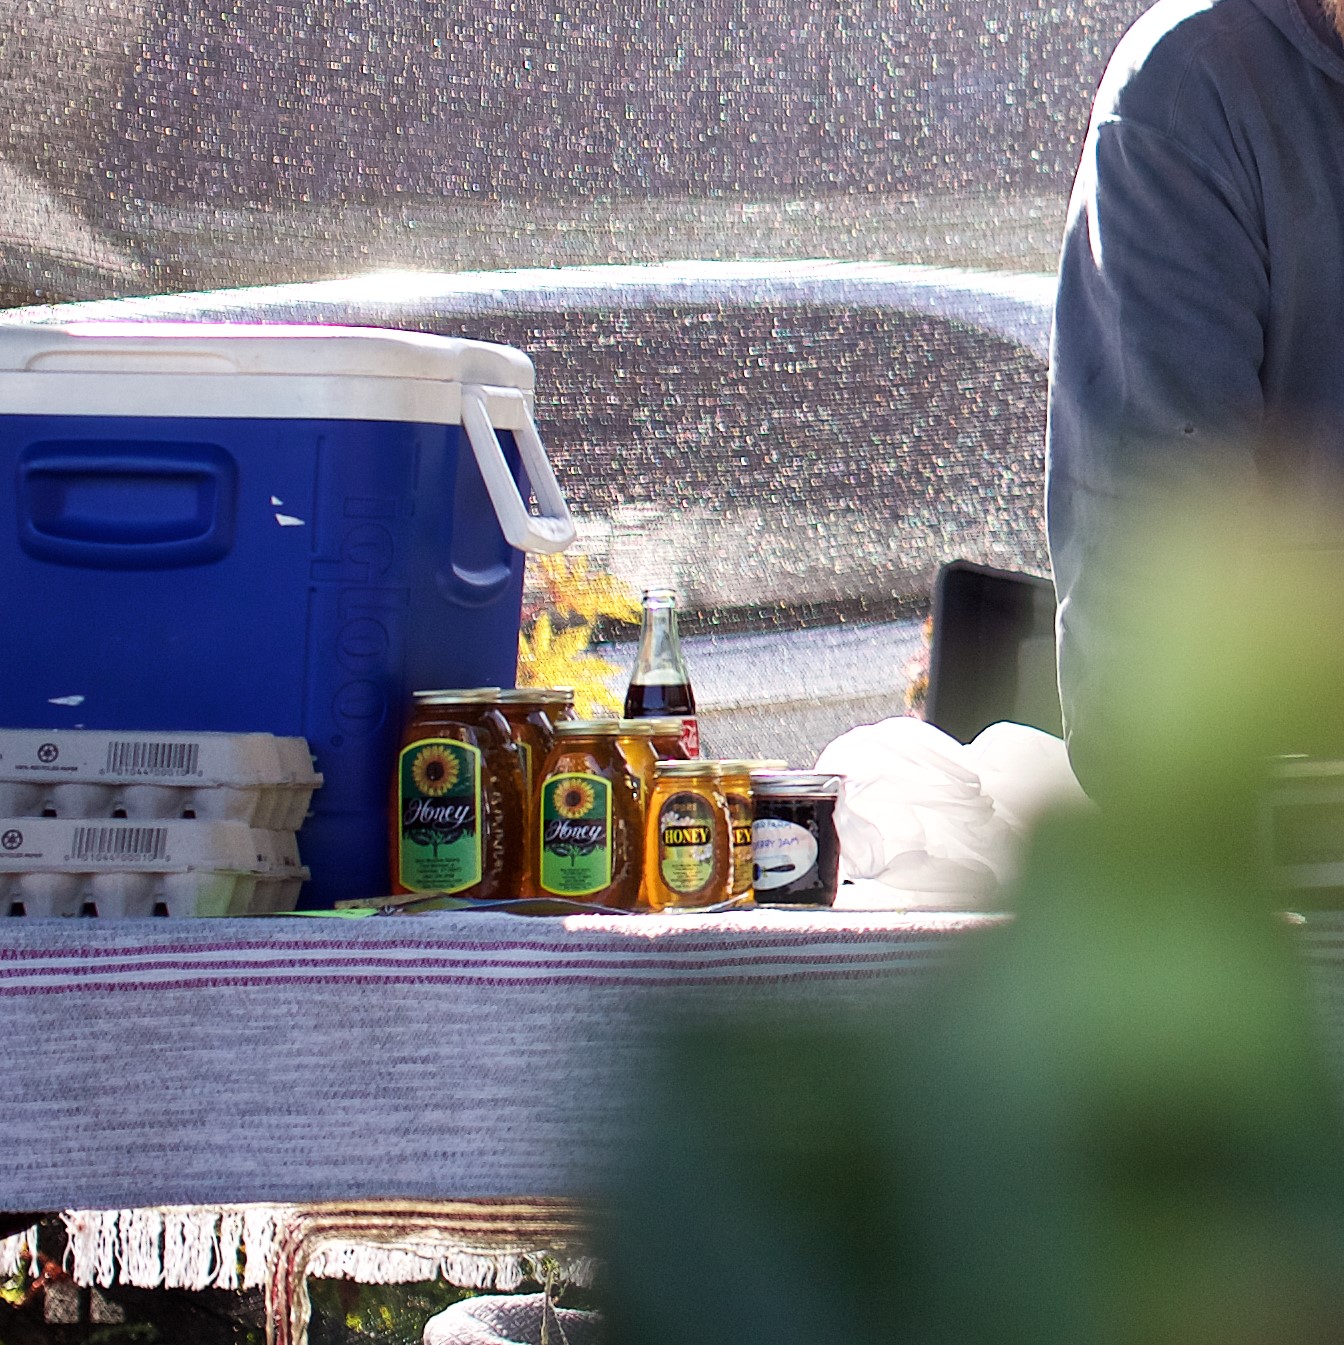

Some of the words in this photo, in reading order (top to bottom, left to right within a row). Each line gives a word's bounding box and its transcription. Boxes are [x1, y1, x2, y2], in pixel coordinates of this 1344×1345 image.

[404, 798, 477, 831] Honey
[545, 820, 606, 846] Honey
[664, 827, 708, 844] HONEY
